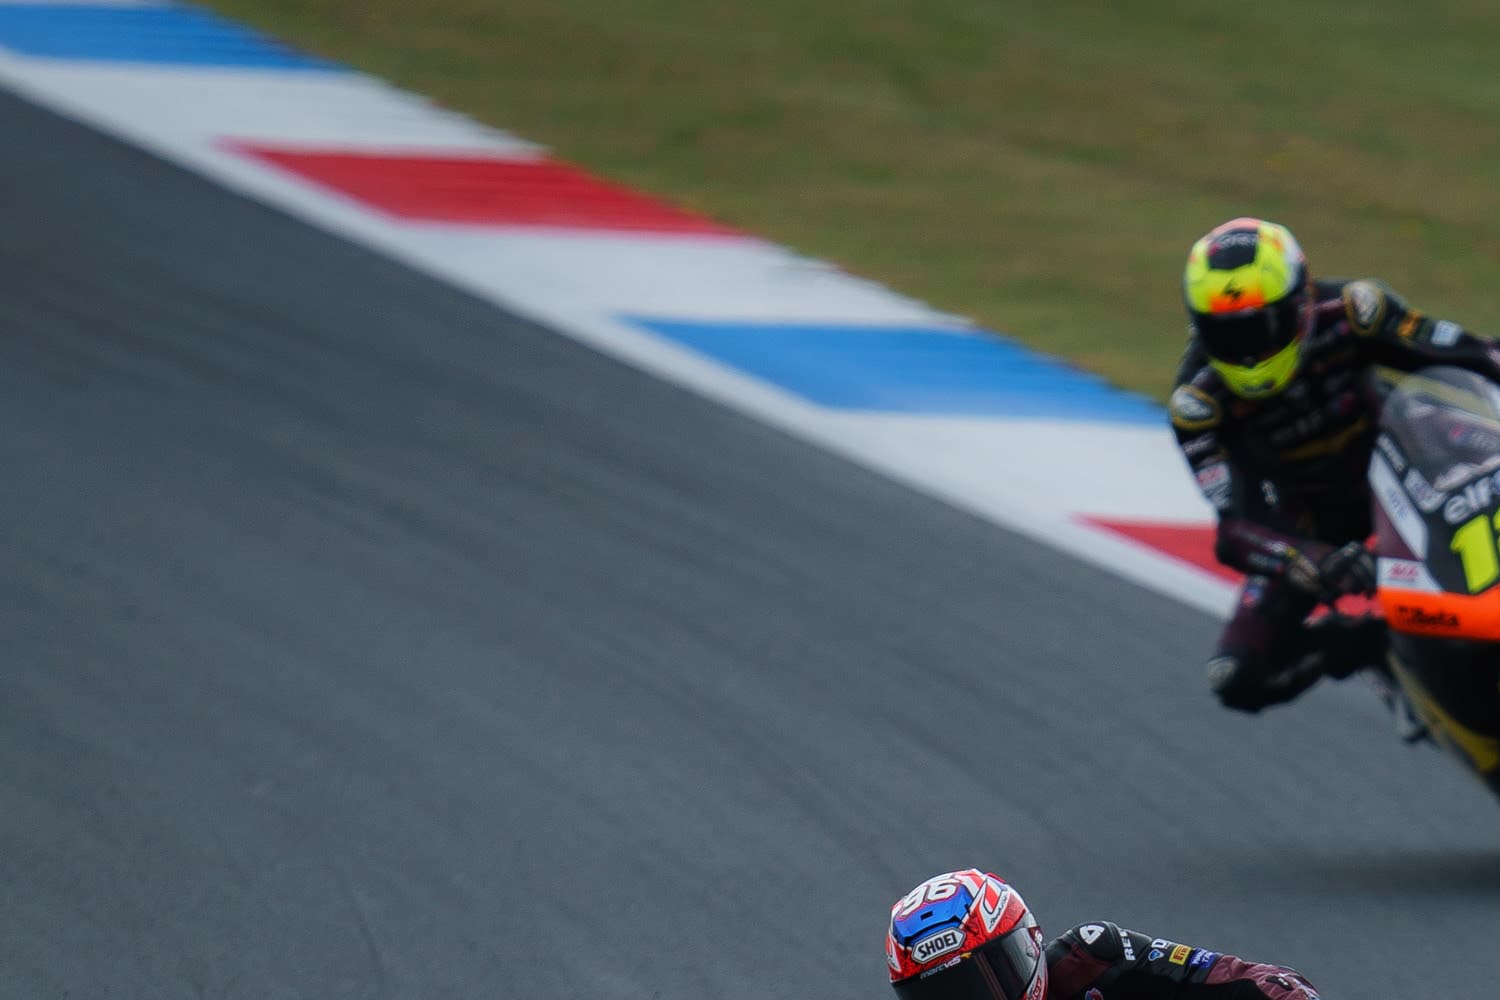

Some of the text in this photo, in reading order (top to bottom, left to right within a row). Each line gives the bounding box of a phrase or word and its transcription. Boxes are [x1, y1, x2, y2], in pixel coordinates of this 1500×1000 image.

[1444, 476, 1492, 525] elf
[900, 874, 962, 919] 96
[917, 931, 958, 959] SHOEI
